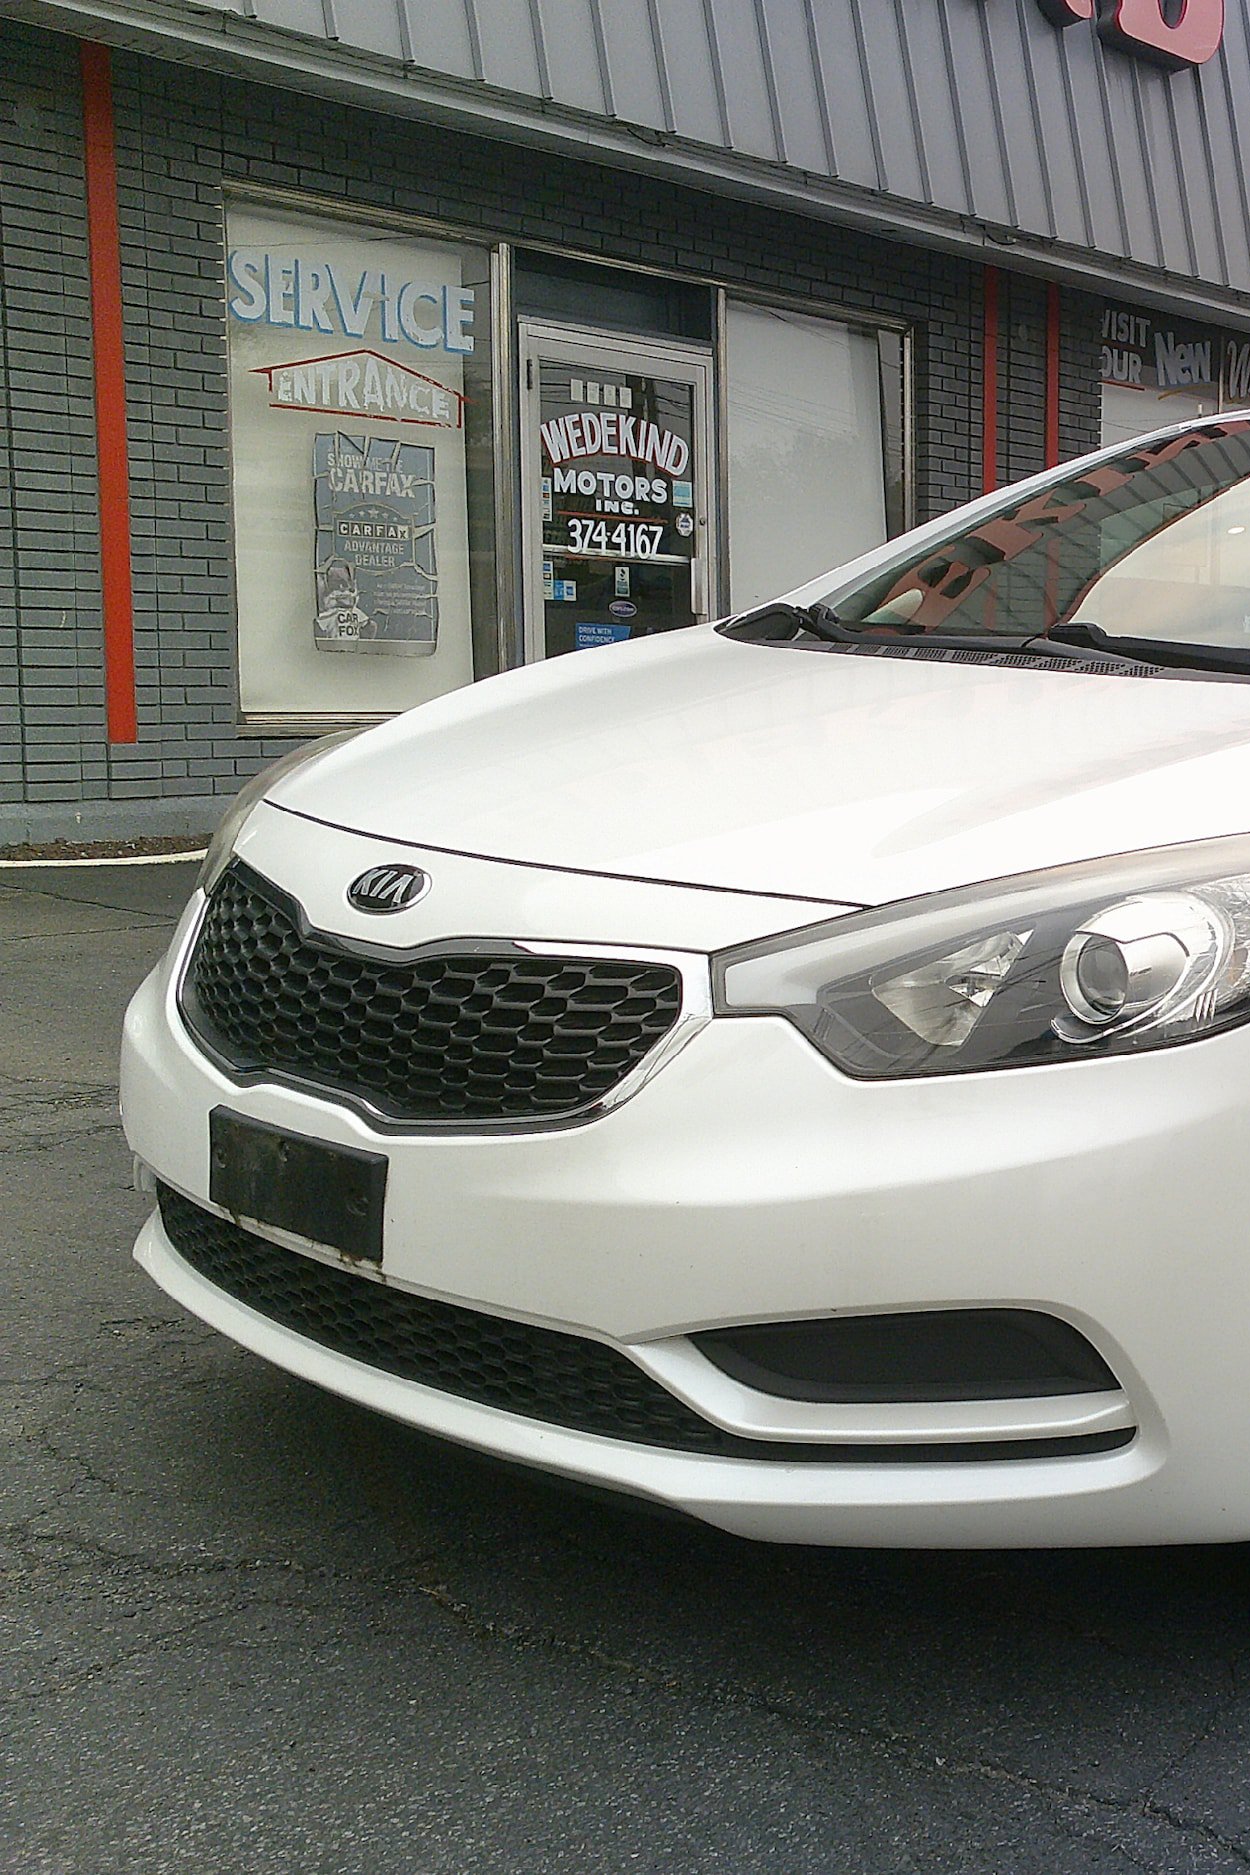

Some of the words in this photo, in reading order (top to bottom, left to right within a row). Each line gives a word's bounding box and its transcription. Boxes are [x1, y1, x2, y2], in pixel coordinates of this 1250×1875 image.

[228, 250, 475, 354] SERVICE
[1100, 309, 1151, 347] VISIT
[1099, 345, 1142, 384] OUR
[1154, 331, 1211, 386] New
[277, 358, 450, 419] ENTRANCE
[540, 412, 689, 477] WEDEKIND
[329, 467, 416, 498] CARFAX
[553, 467, 668, 504] MOTORS
[595, 499, 640, 515] INC.
[339, 522, 409, 540] CARFAX
[344, 540, 405, 555] ADVANTAGE
[567, 518, 664, 559] 374-4167
[355, 554, 396, 567] DEALER
[338, 613, 359, 624] CAR
[338, 624, 359, 637] FOX
[352, 868, 414, 904] KIA
